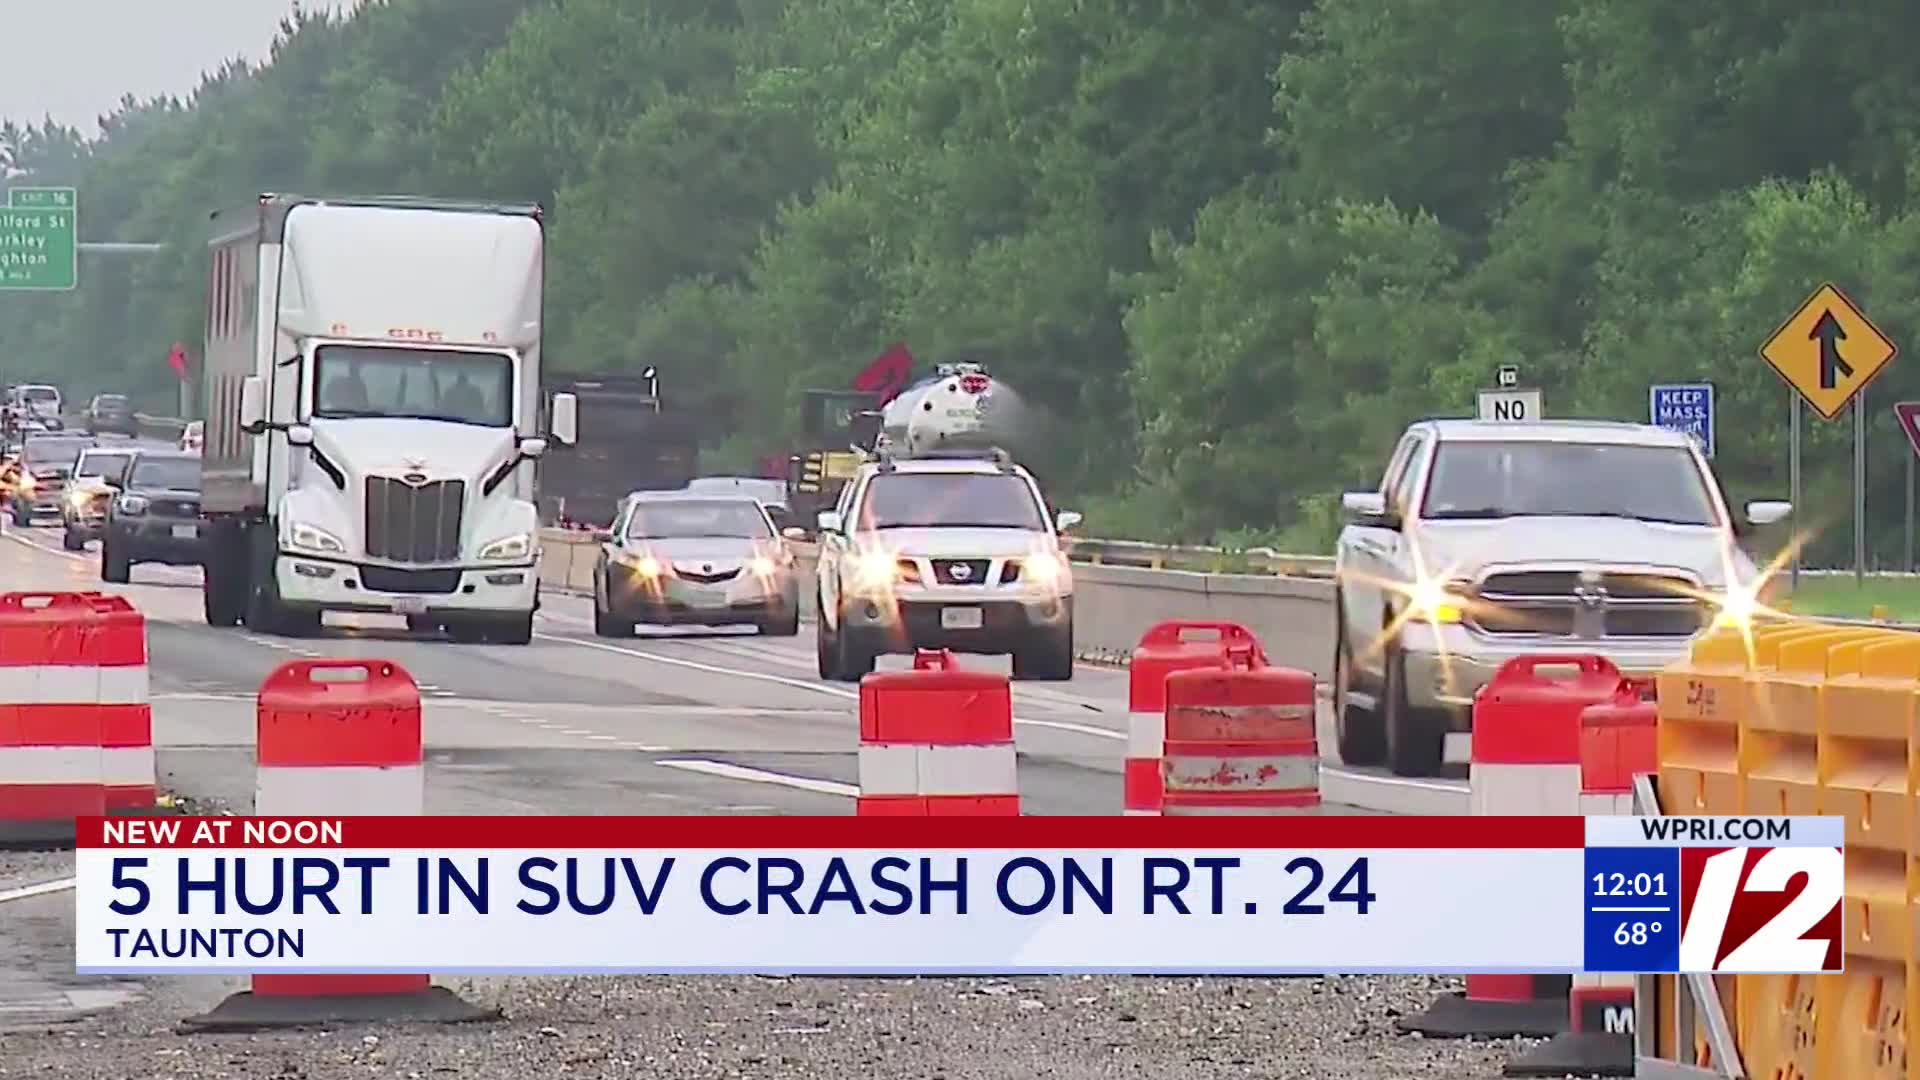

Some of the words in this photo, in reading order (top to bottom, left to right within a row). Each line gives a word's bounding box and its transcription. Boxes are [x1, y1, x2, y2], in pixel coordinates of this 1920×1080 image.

[49, 215, 65, 228] St
[1661, 391, 1702, 405] KEEP
[1495, 400, 1525, 420] NO
